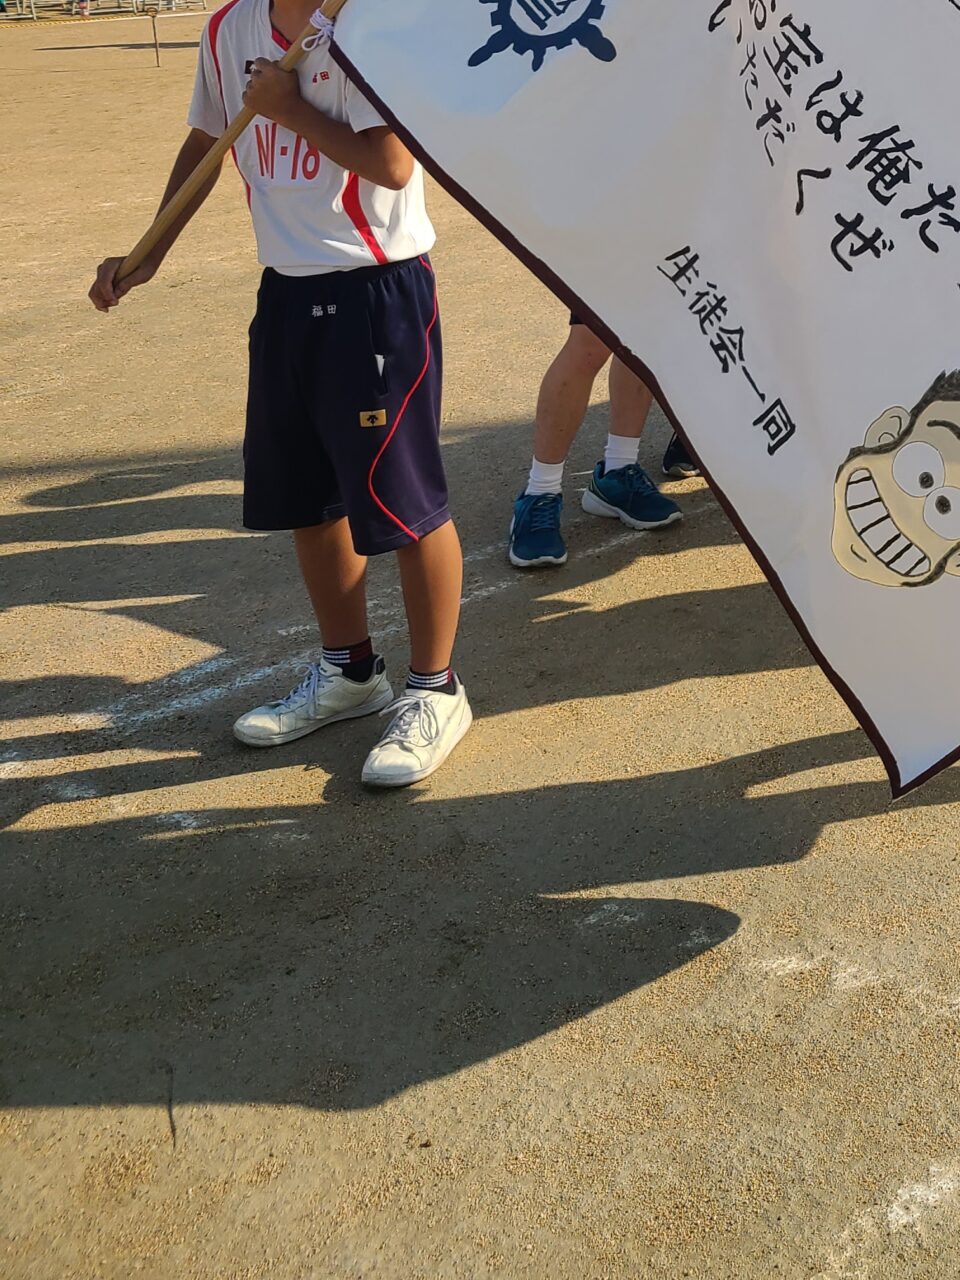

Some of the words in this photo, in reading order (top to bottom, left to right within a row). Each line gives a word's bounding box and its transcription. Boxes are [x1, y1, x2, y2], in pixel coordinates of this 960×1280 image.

[656, 246, 796, 456] 生徒会一同
